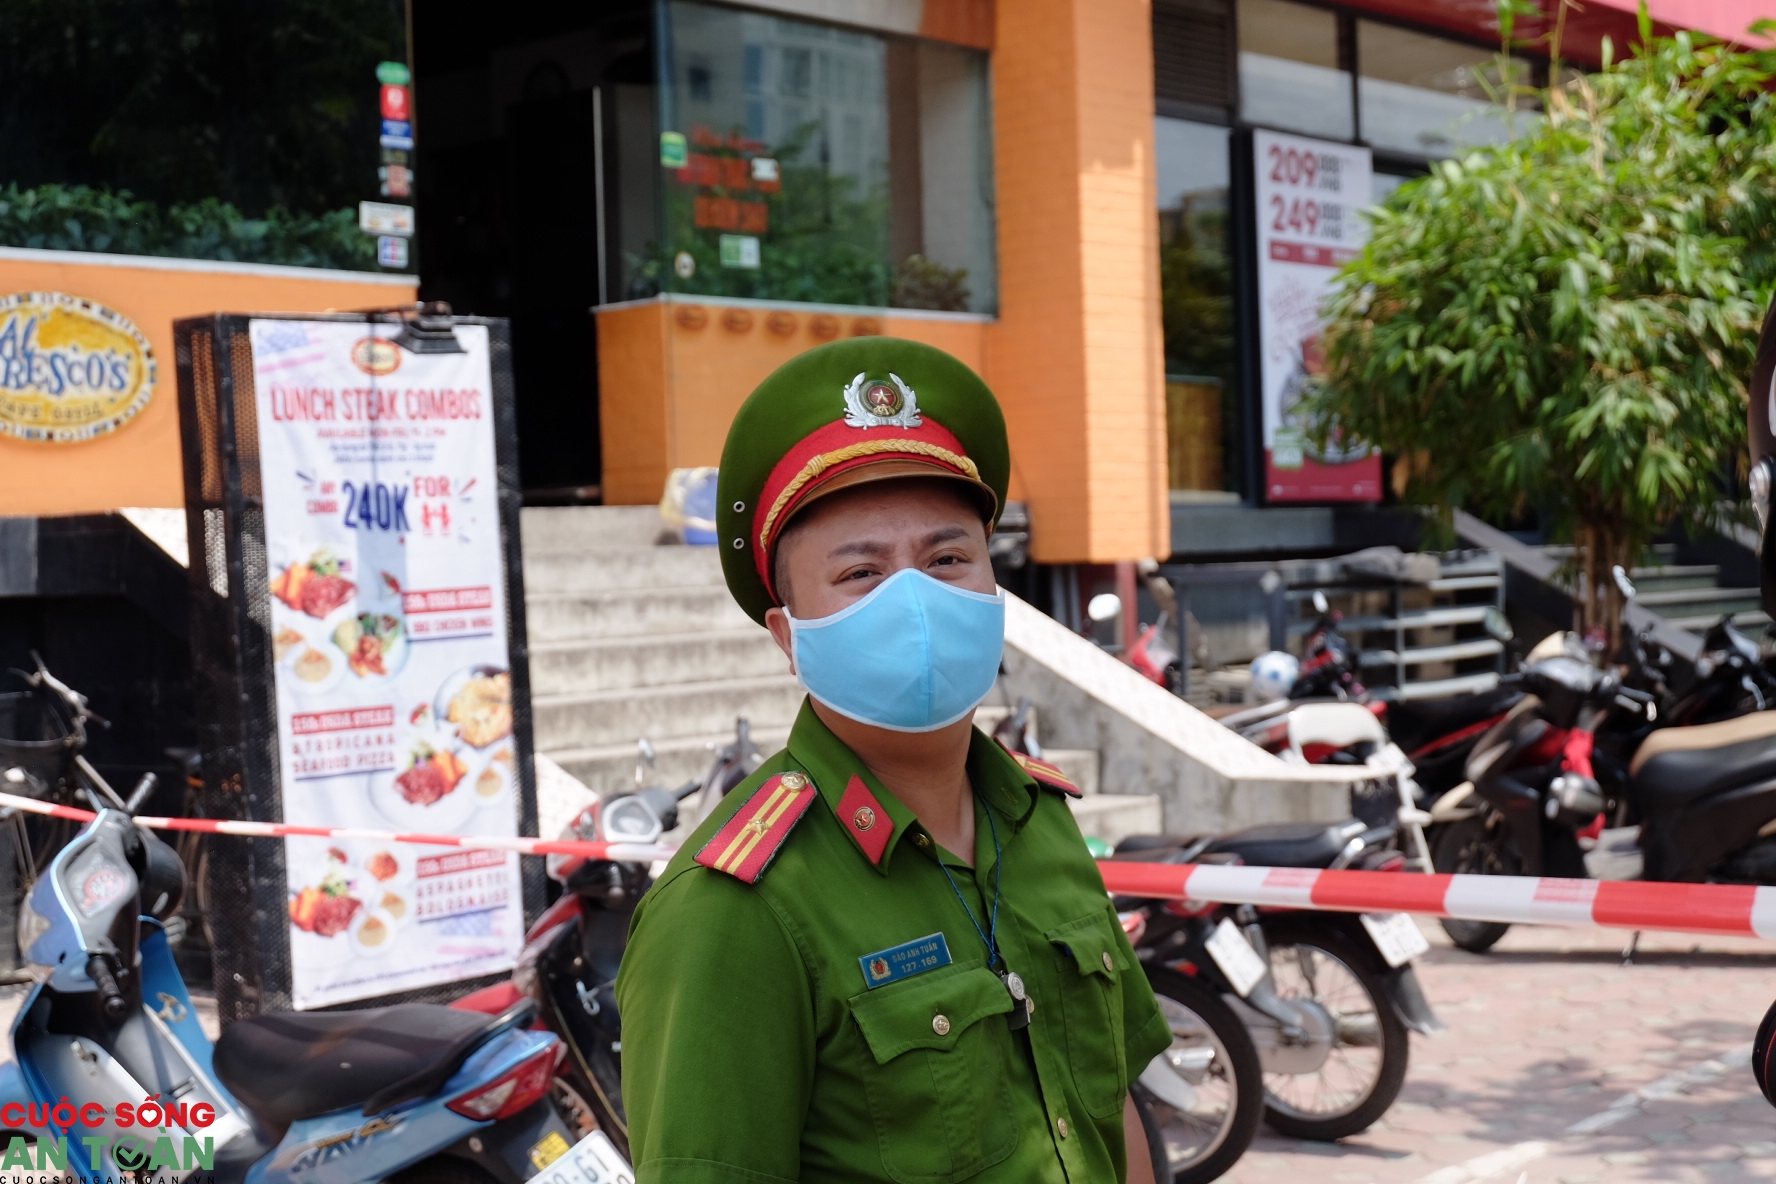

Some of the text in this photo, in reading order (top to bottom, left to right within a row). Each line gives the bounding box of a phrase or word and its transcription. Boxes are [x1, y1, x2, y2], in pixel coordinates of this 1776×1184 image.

[1269, 146, 1317, 187] 209
[1271, 195, 1320, 236] 249
[0, 350, 128, 396] RESCO'S
[271, 387, 482, 421] LUNCH STEAK COMBOS
[413, 476, 451, 498] FOR
[342, 481, 410, 532] 240K
[901, 955, 938, 973] 127 169
[907, 948, 920, 959] ANH
